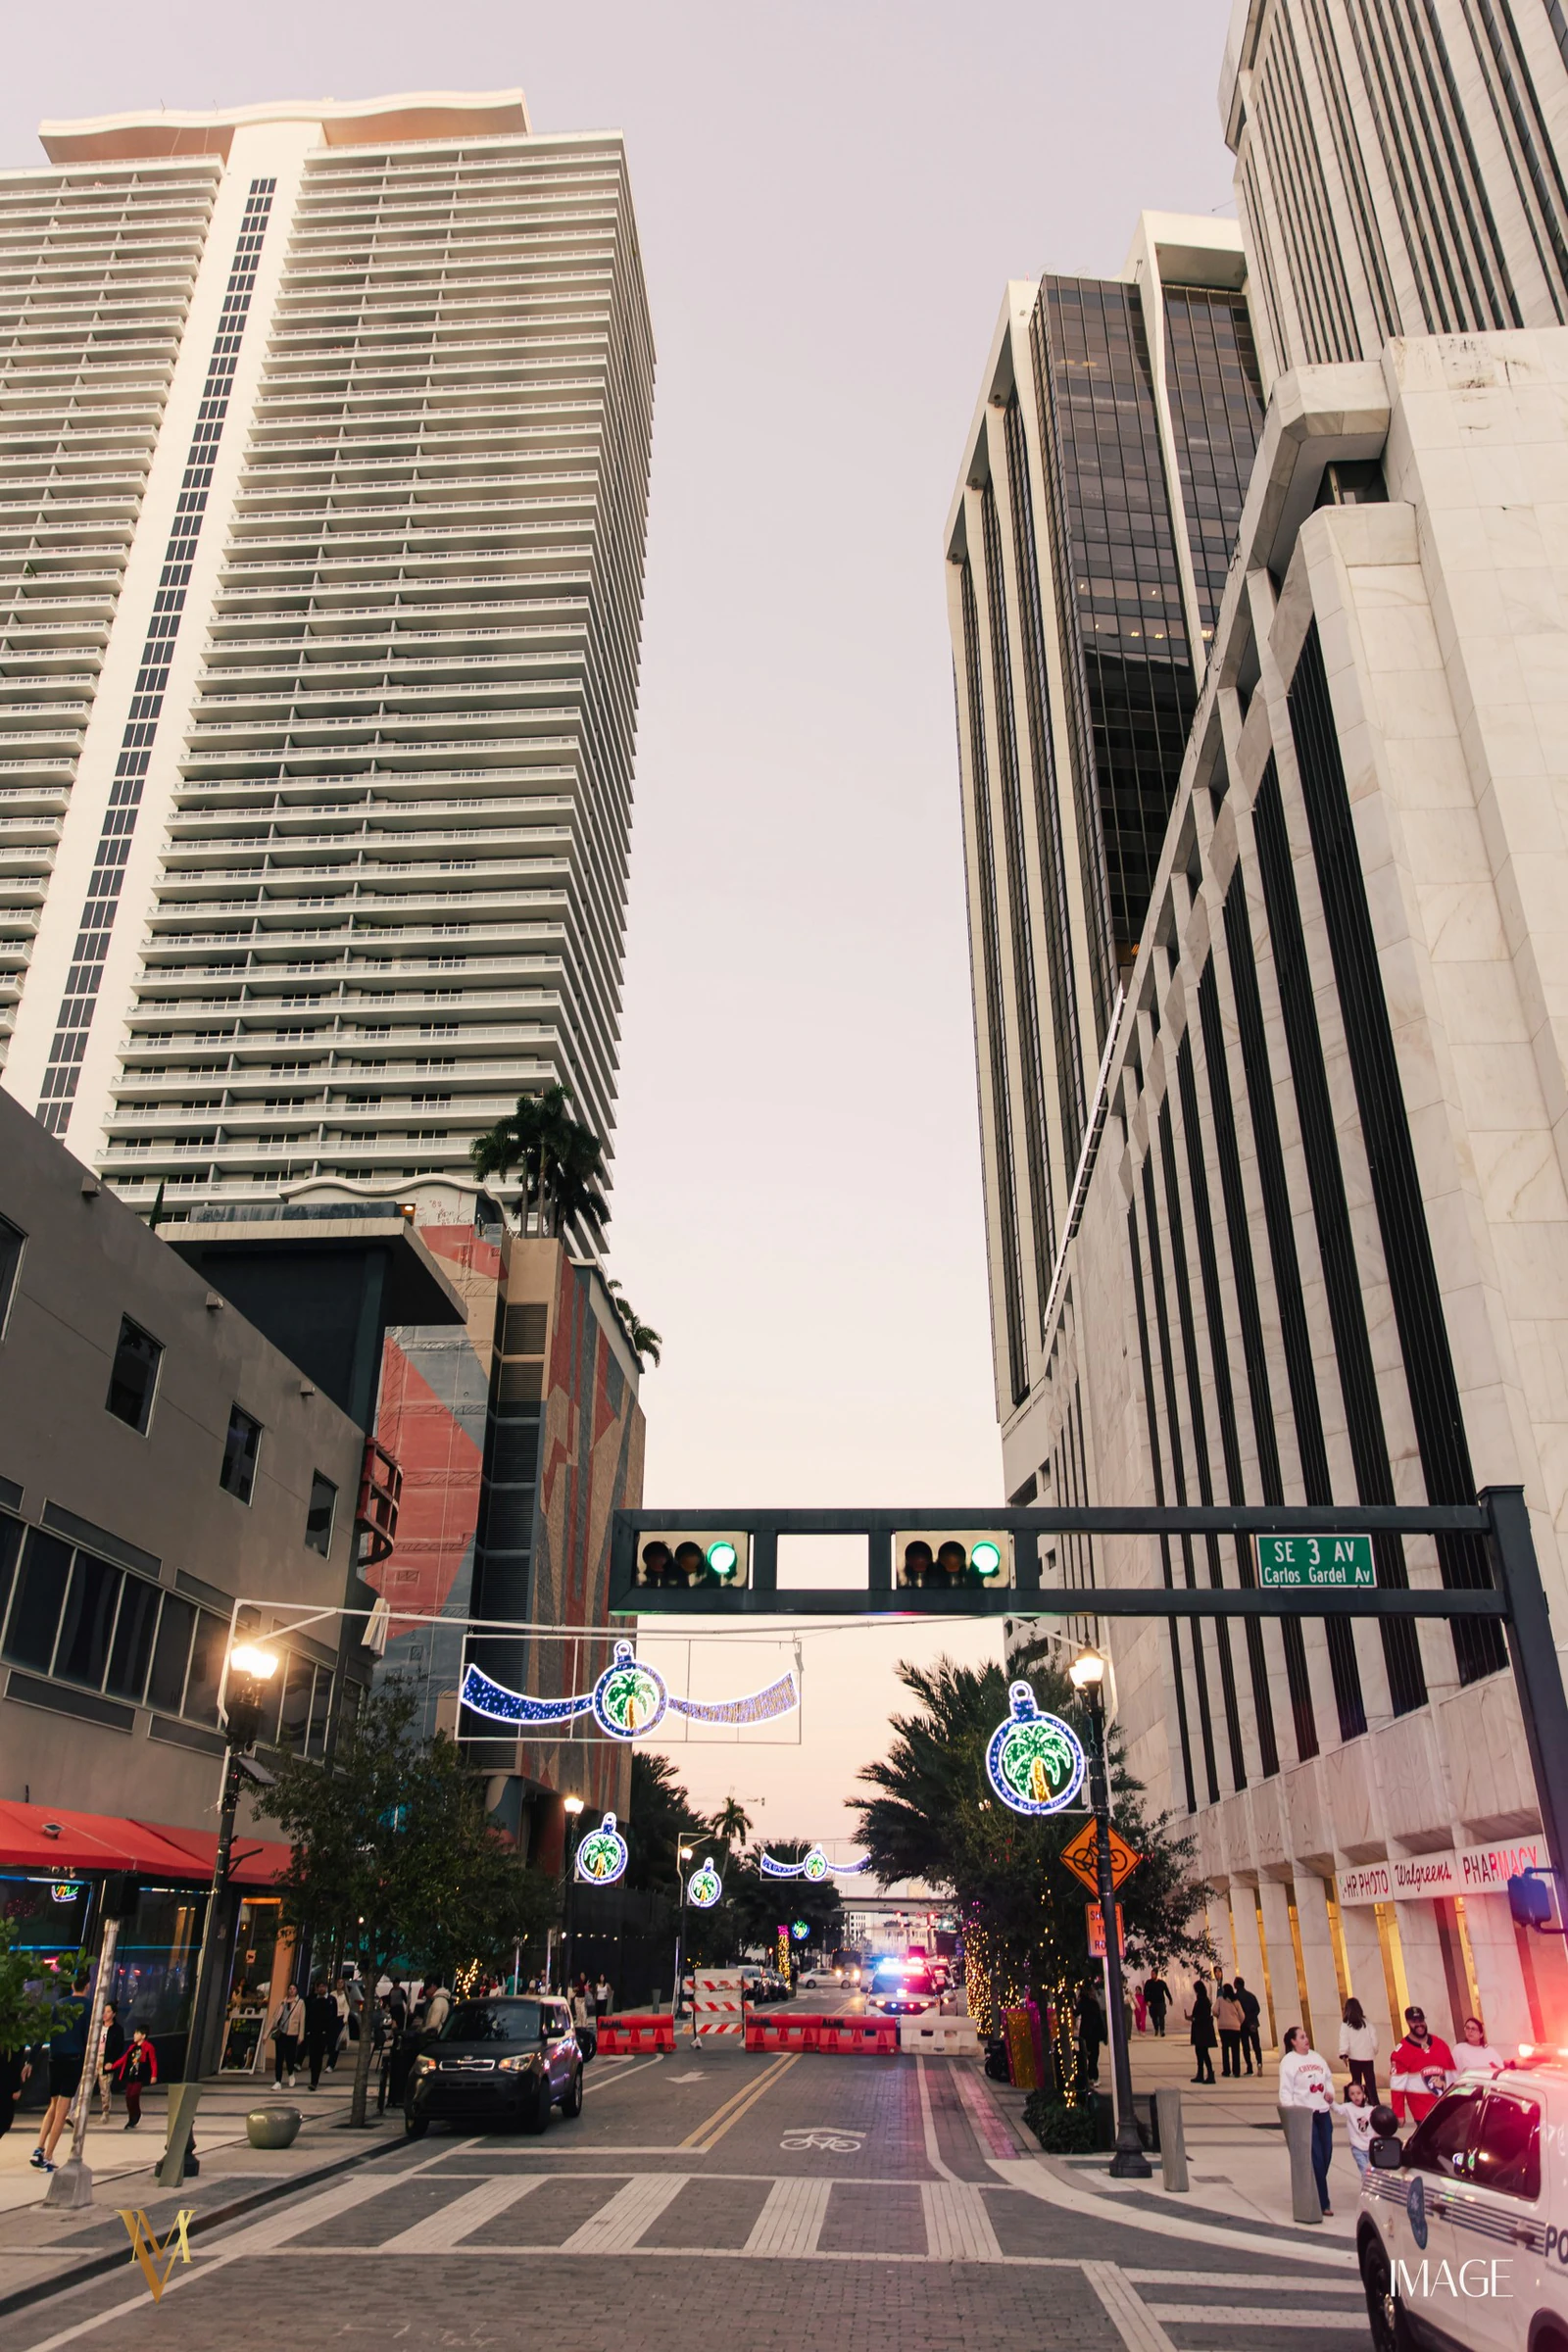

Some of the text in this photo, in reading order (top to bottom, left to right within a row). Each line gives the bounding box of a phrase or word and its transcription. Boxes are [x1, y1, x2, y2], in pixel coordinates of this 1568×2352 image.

[1274, 1539, 1354, 1565] SE 3 AV
[1264, 1566, 1371, 1584] Carlos Gardel Av
[1358, 1869, 1389, 1897] PHOTO
[1395, 1861, 1452, 1892] Walgreens
[1462, 1845, 1539, 1885] PHARMACY
